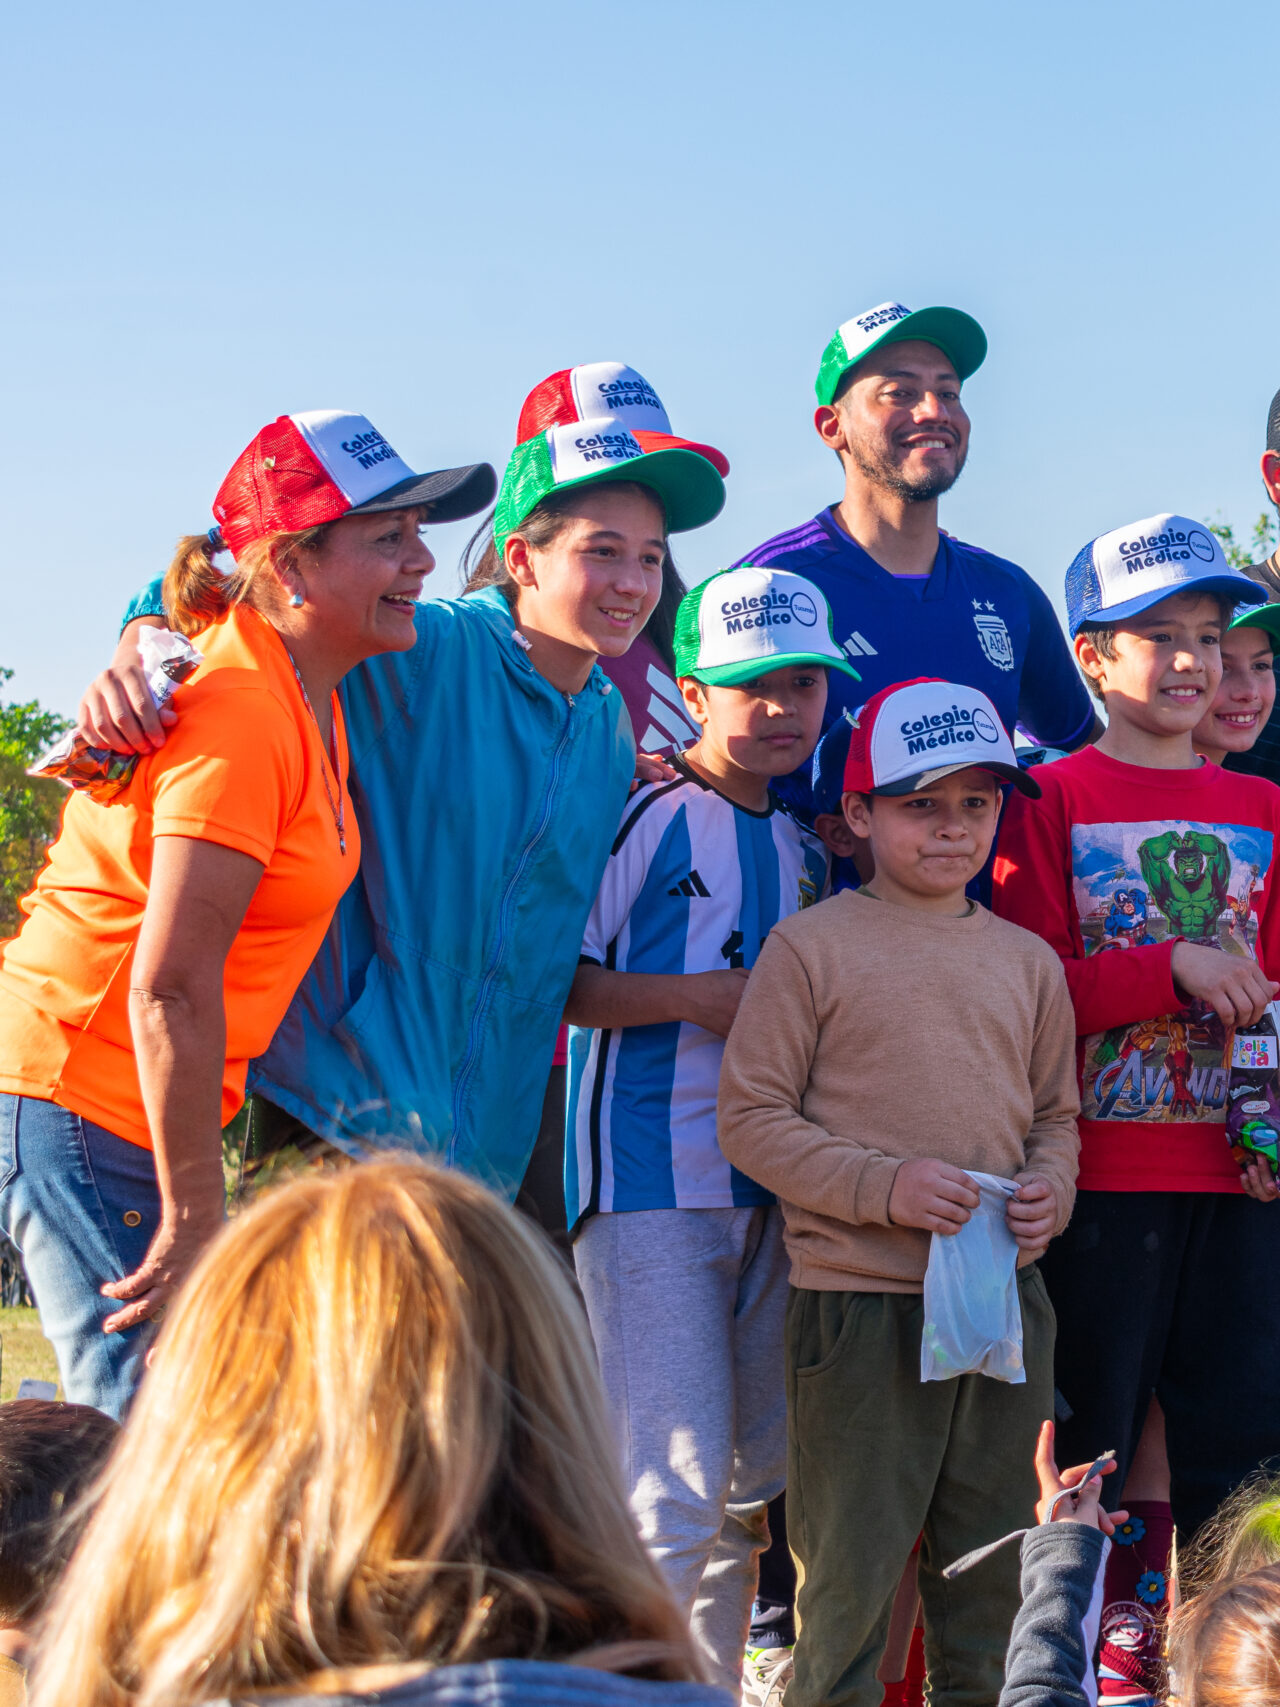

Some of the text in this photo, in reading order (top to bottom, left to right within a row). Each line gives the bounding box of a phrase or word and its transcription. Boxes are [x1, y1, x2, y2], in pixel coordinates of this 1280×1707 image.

[598, 379, 655, 393] Colegio
[606, 393, 660, 409] Médico
[575, 432, 638, 449] Colegio
[583, 447, 640, 462] Médic
[1119, 528, 1186, 555] Colegio
[1126, 548, 1191, 575] Médico
[721, 587, 789, 615] Colegio
[726, 609, 792, 635] Médico
[900, 704, 970, 735] Colegio
[907, 727, 976, 756] Médico
